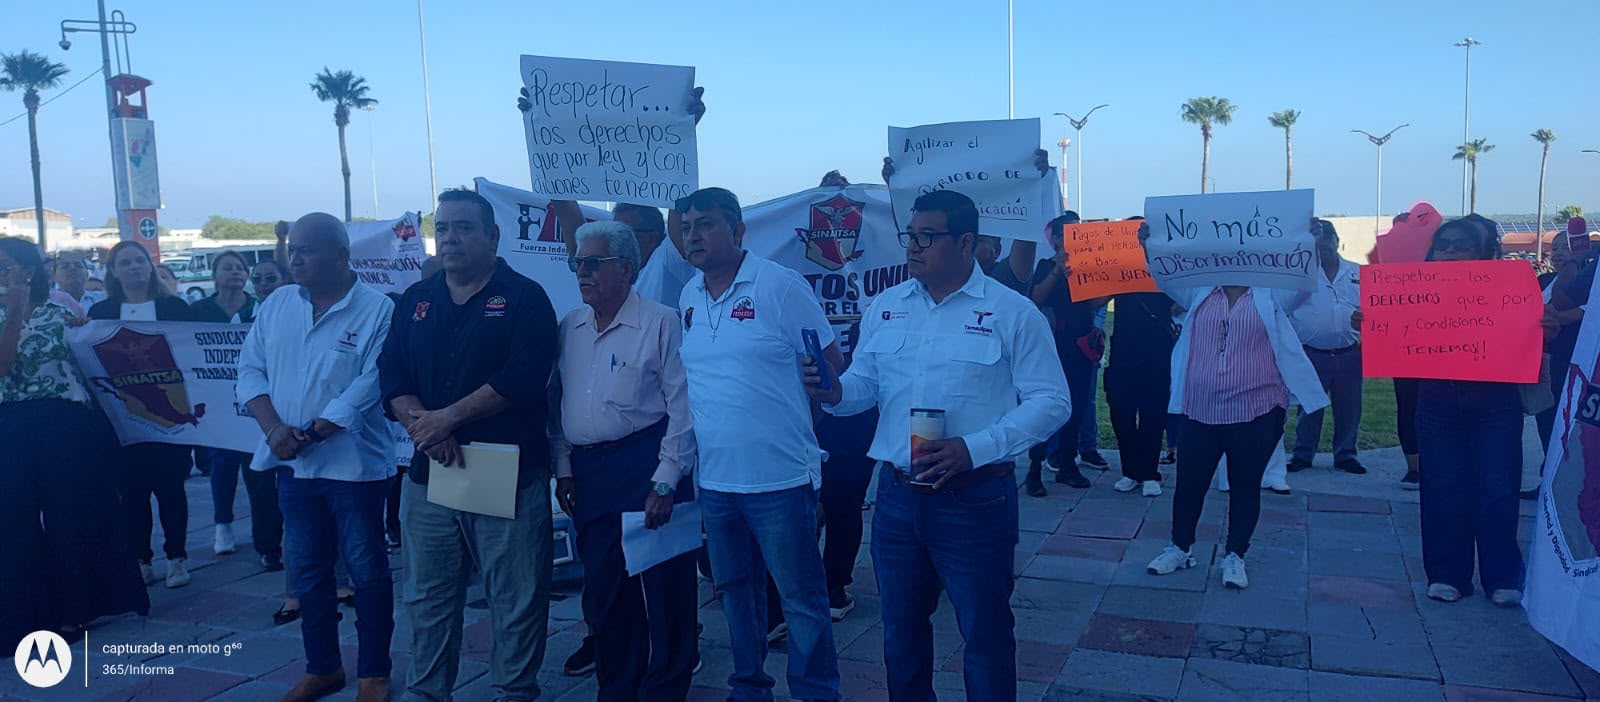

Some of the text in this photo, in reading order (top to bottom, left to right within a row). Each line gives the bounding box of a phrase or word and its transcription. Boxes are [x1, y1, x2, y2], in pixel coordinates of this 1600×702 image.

[531, 112, 682, 150] los derechos
[904, 136, 979, 165] Agilizar el
[532, 152, 559, 177] que
[564, 152, 591, 174] por
[598, 145, 626, 173] ley
[630, 152, 648, 178] y
[1005, 170, 1022, 179] DE
[603, 171, 690, 201] tenemos
[1165, 205, 1283, 245] No más
[1072, 227, 1099, 244] Pagos
[1105, 226, 1114, 235] de
[520, 243, 547, 252] Fuerza
[1073, 247, 1092, 255] para
[1098, 243, 1104, 251] el
[1153, 242, 1313, 276] Discriminación
[1077, 271, 1110, 286] IMSS
[841, 301, 861, 315] EL
[1369, 292, 1535, 311] DERECHOS que por
[1370, 315, 1495, 337] ley y Condiciones
[203, 348, 241, 364] INDEP
[113, 370, 182, 387] SINAITSA
[1551, 536, 1571, 574] Dignidad
[1572, 563, 1599, 578] Sindical
